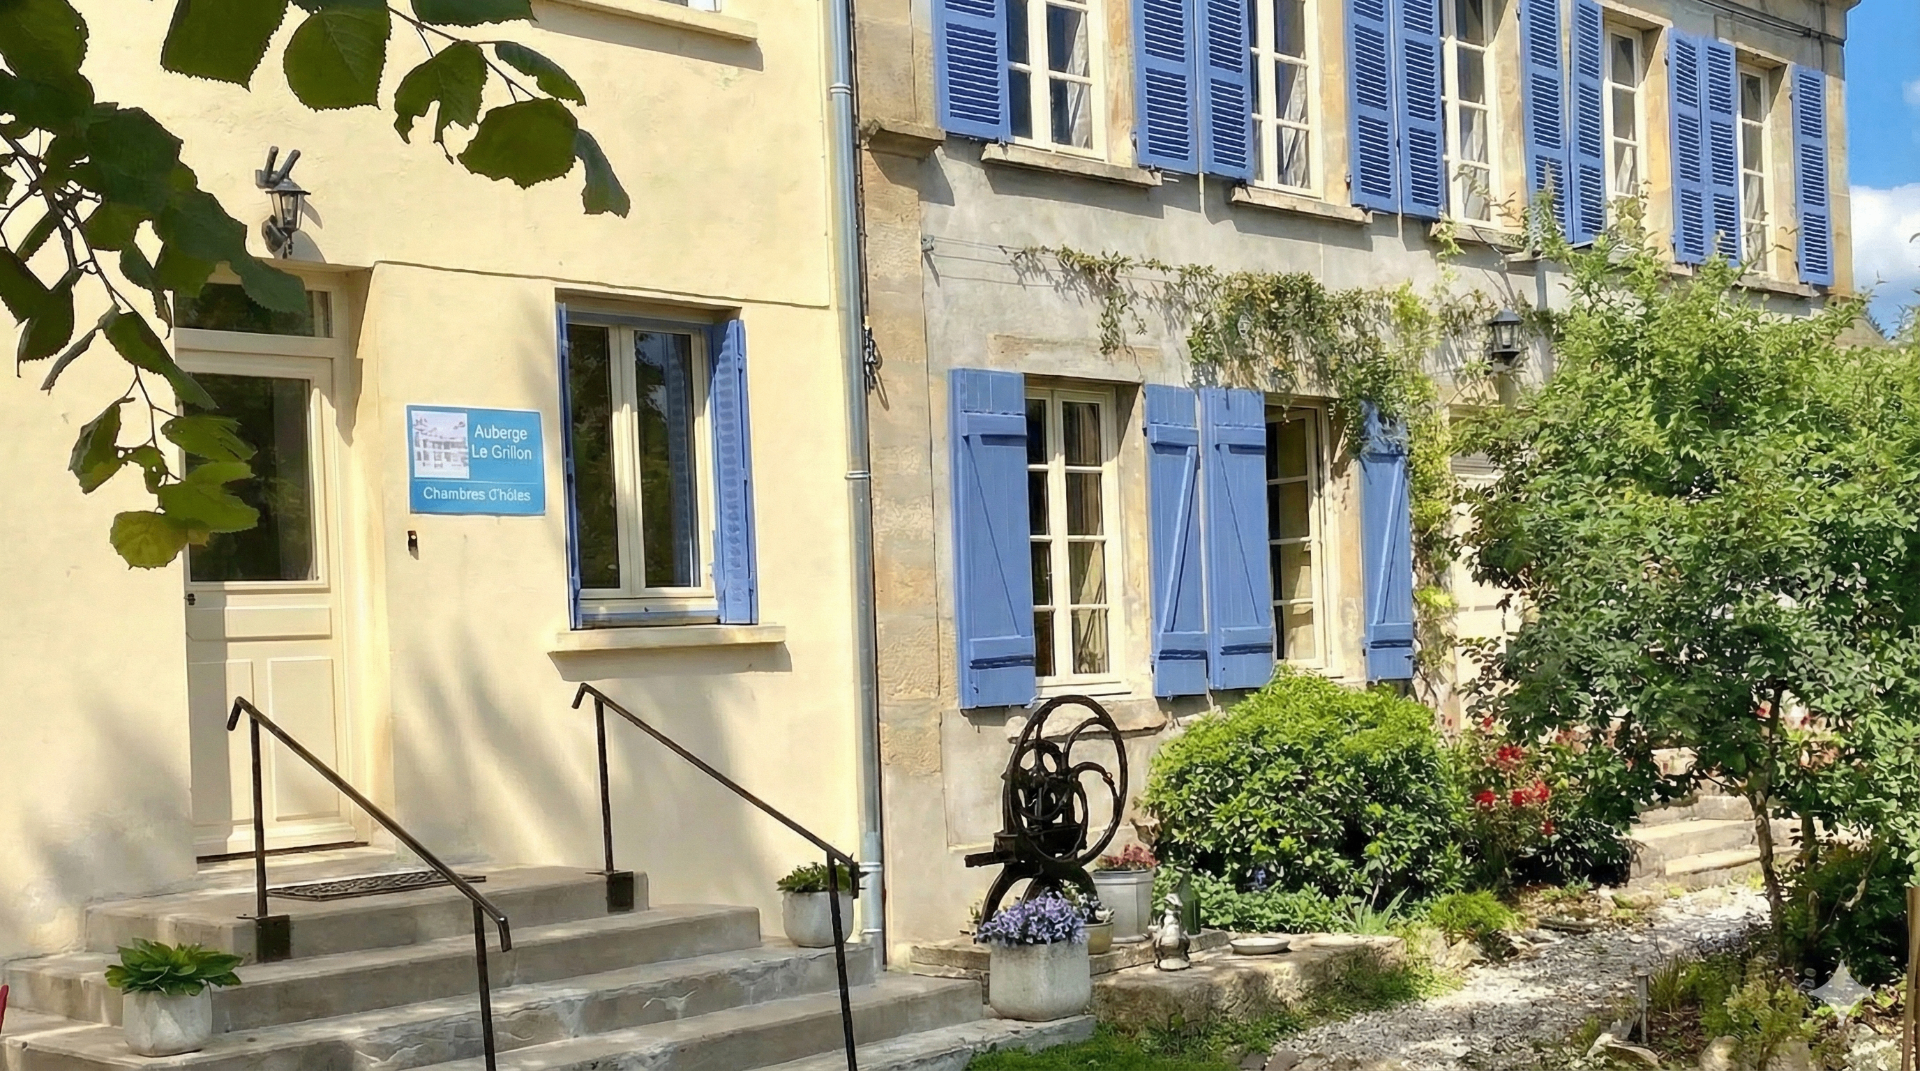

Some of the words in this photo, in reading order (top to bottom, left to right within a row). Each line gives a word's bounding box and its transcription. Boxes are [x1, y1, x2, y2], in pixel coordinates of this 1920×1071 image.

[474, 424, 528, 443] Auberge
[471, 444, 488, 459] Le
[491, 445, 532, 460] Grillon
[423, 487, 486, 500] Chambres
